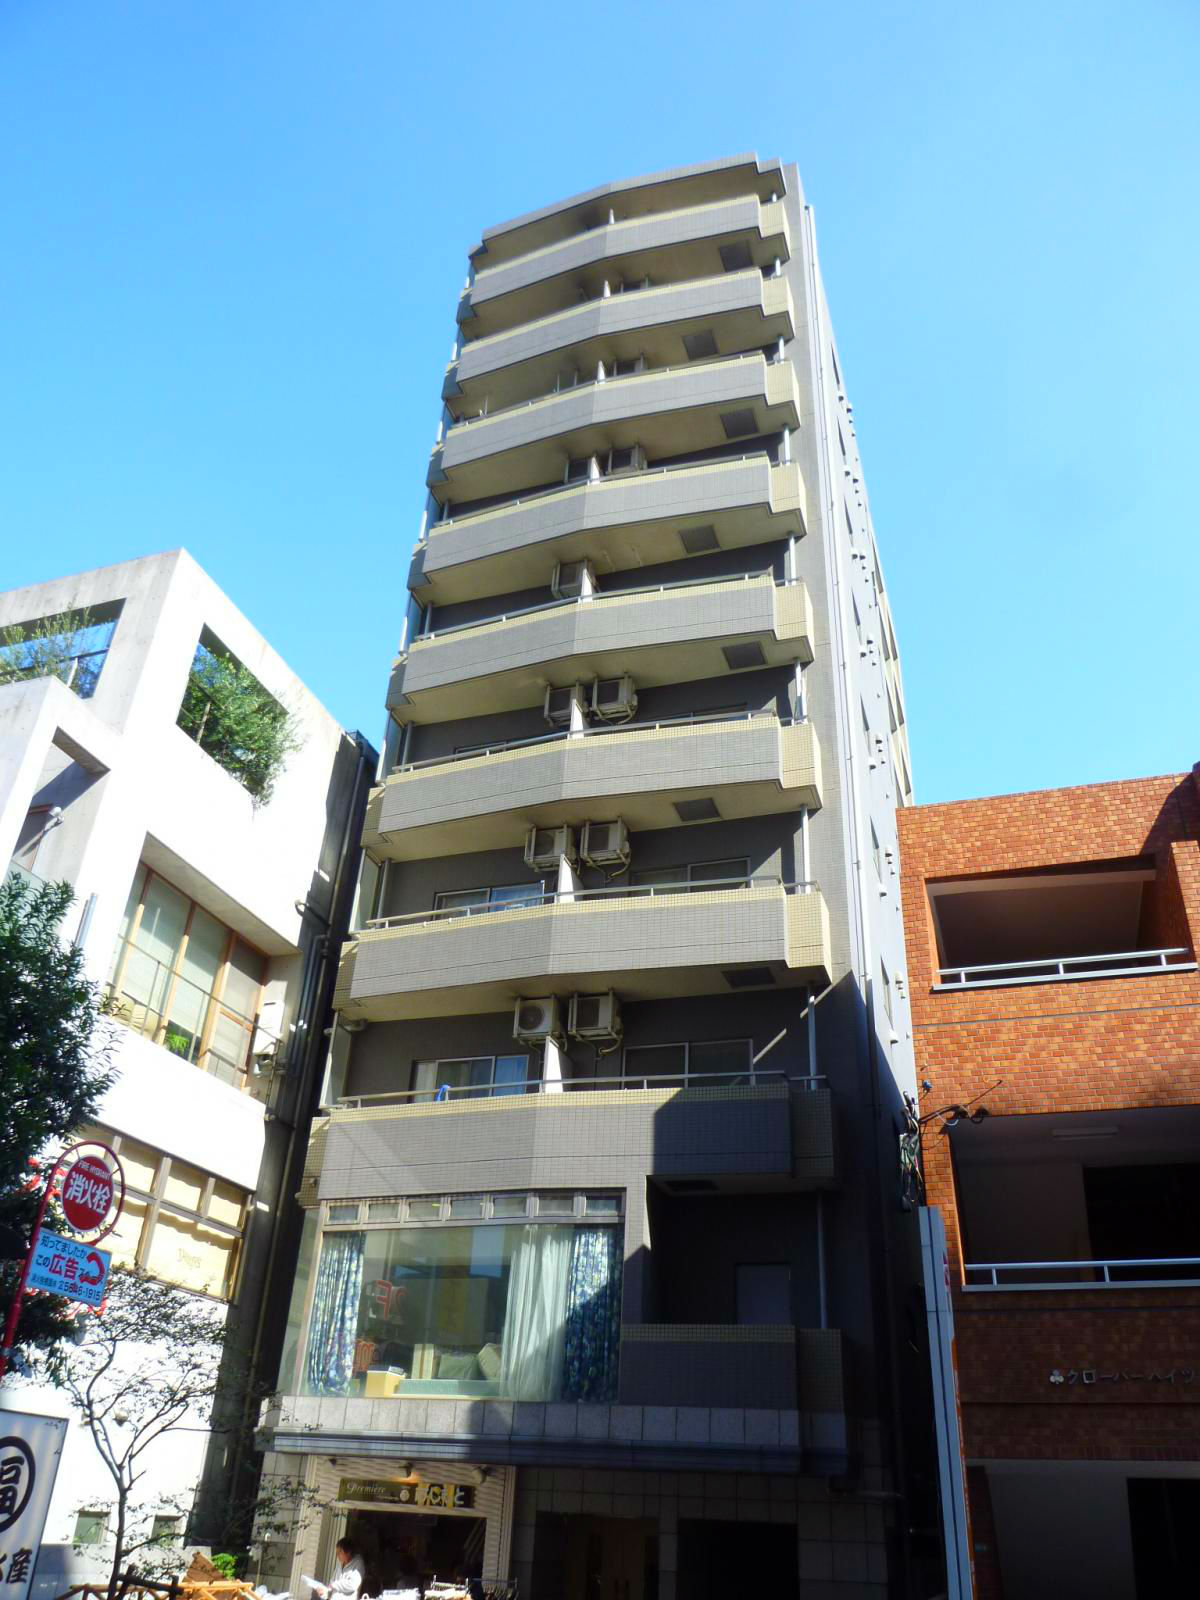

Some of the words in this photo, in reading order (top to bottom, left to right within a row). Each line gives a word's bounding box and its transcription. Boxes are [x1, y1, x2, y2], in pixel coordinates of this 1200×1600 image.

[65, 1171, 110, 1214] 消火栓
[40, 1235, 87, 1259] 知ってましたか
